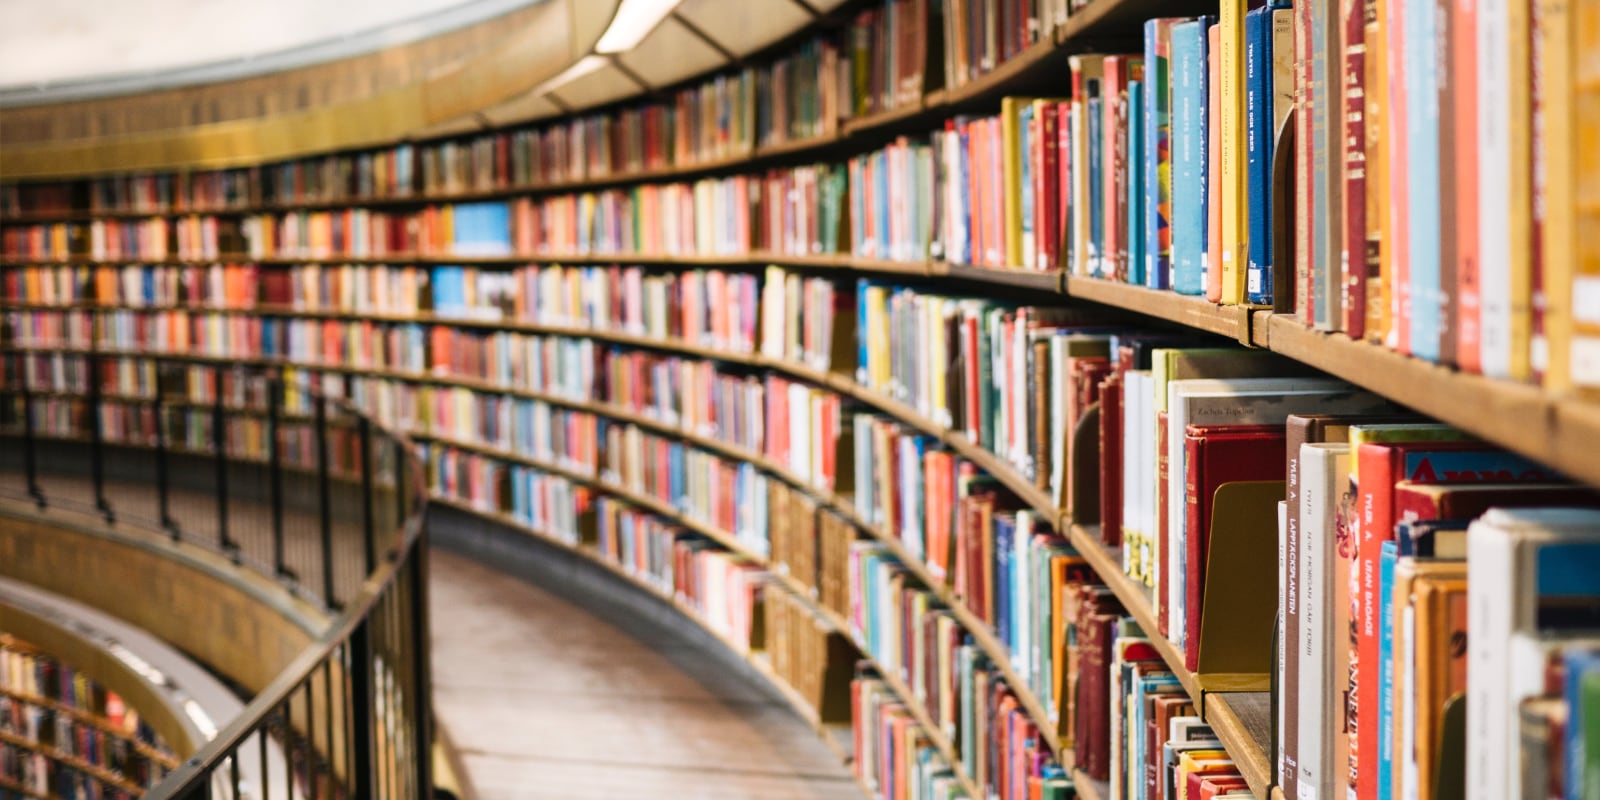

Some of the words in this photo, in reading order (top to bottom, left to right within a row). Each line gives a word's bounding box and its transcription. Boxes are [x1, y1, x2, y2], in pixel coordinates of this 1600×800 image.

[1289, 518, 1297, 615] LAPPTÄCKSPLANETEN
[1365, 559, 1373, 589] UTAN
[1364, 591, 1373, 637] BAGAGE
[1348, 652, 1359, 711] ANNE
[1348, 715, 1359, 779] TYLER
